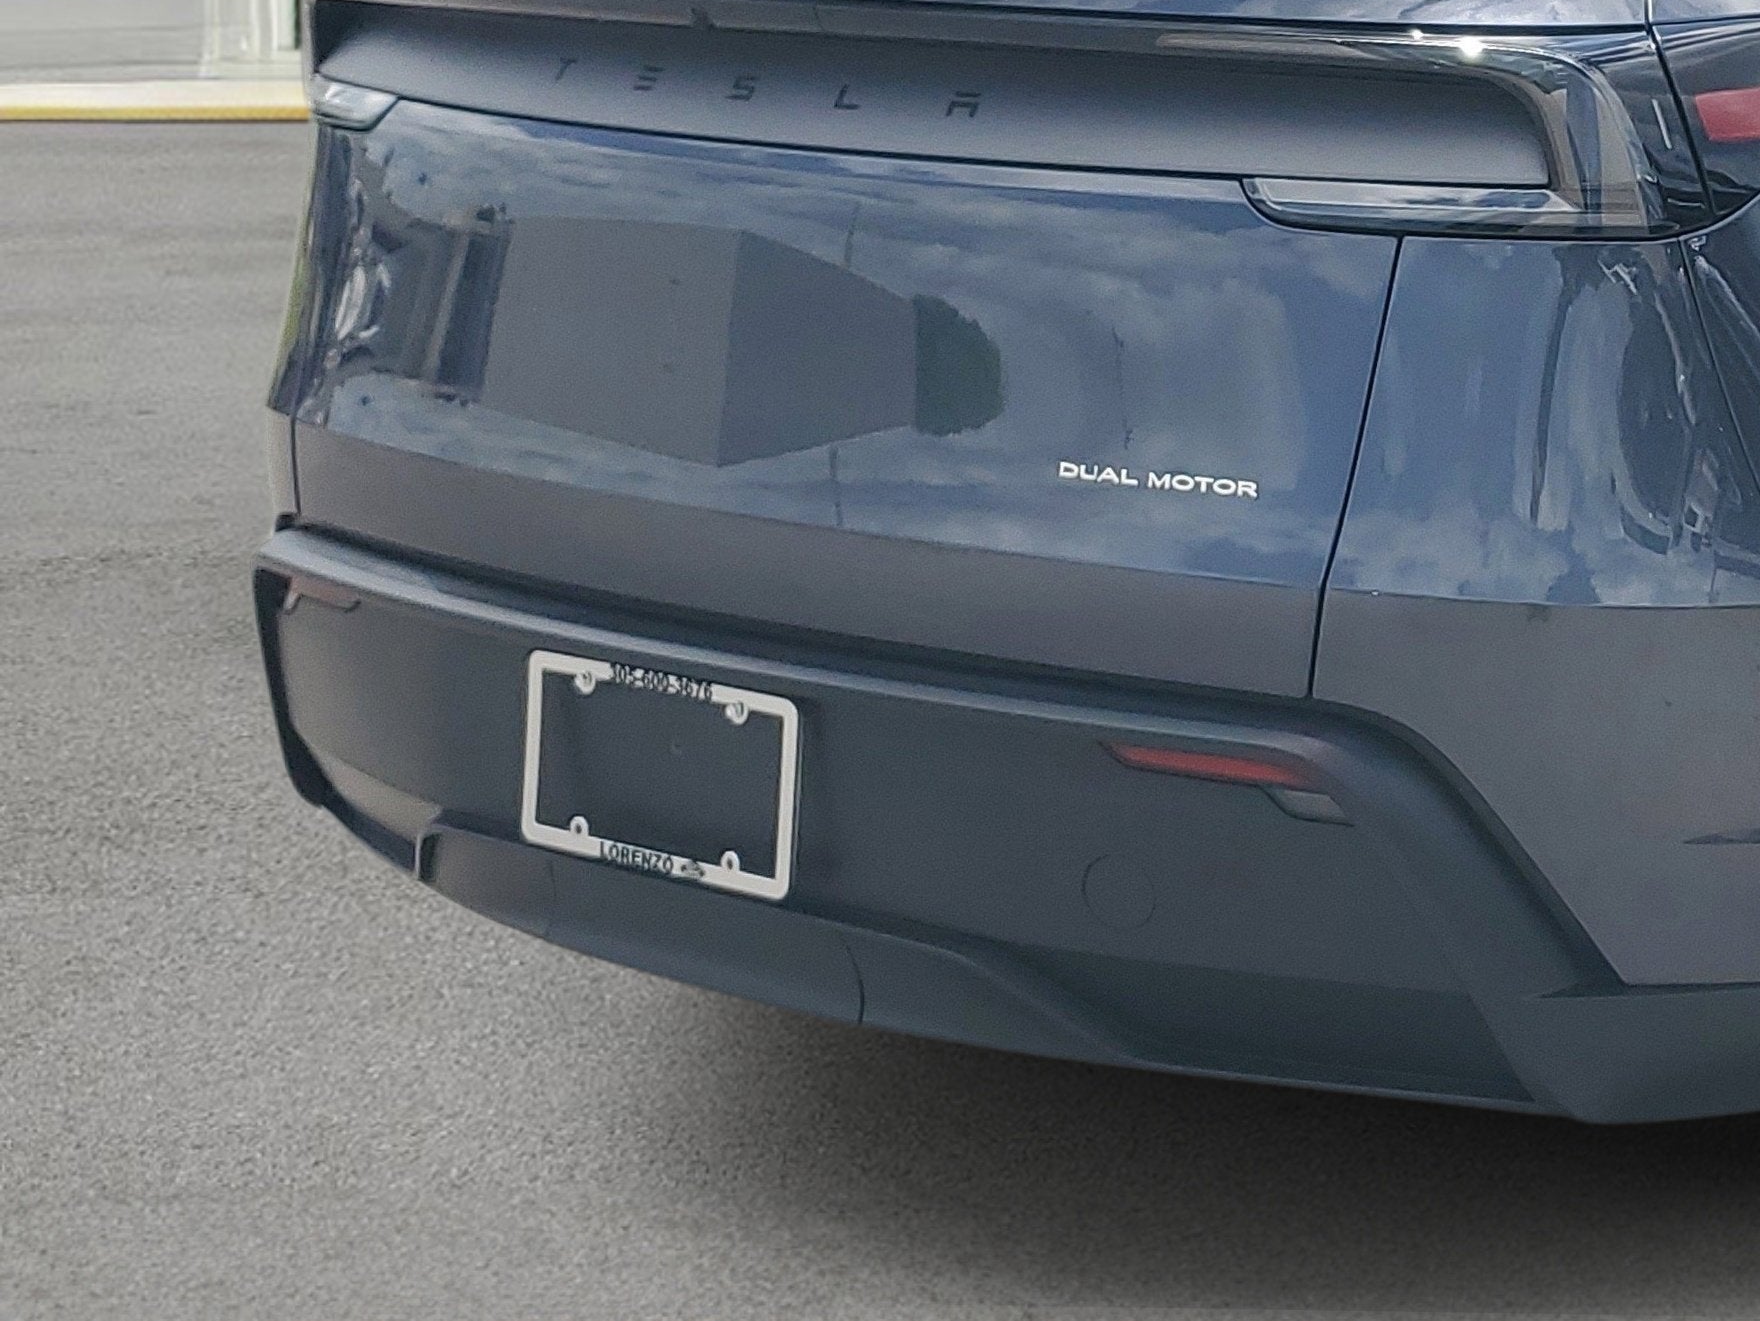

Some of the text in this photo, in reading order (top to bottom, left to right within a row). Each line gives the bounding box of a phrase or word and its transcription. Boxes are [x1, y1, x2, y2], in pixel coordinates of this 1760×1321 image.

[555, 57, 981, 118] TESLA
[1058, 461, 1258, 499] DUAL MOTOR
[600, 840, 674, 874] LORENZO
